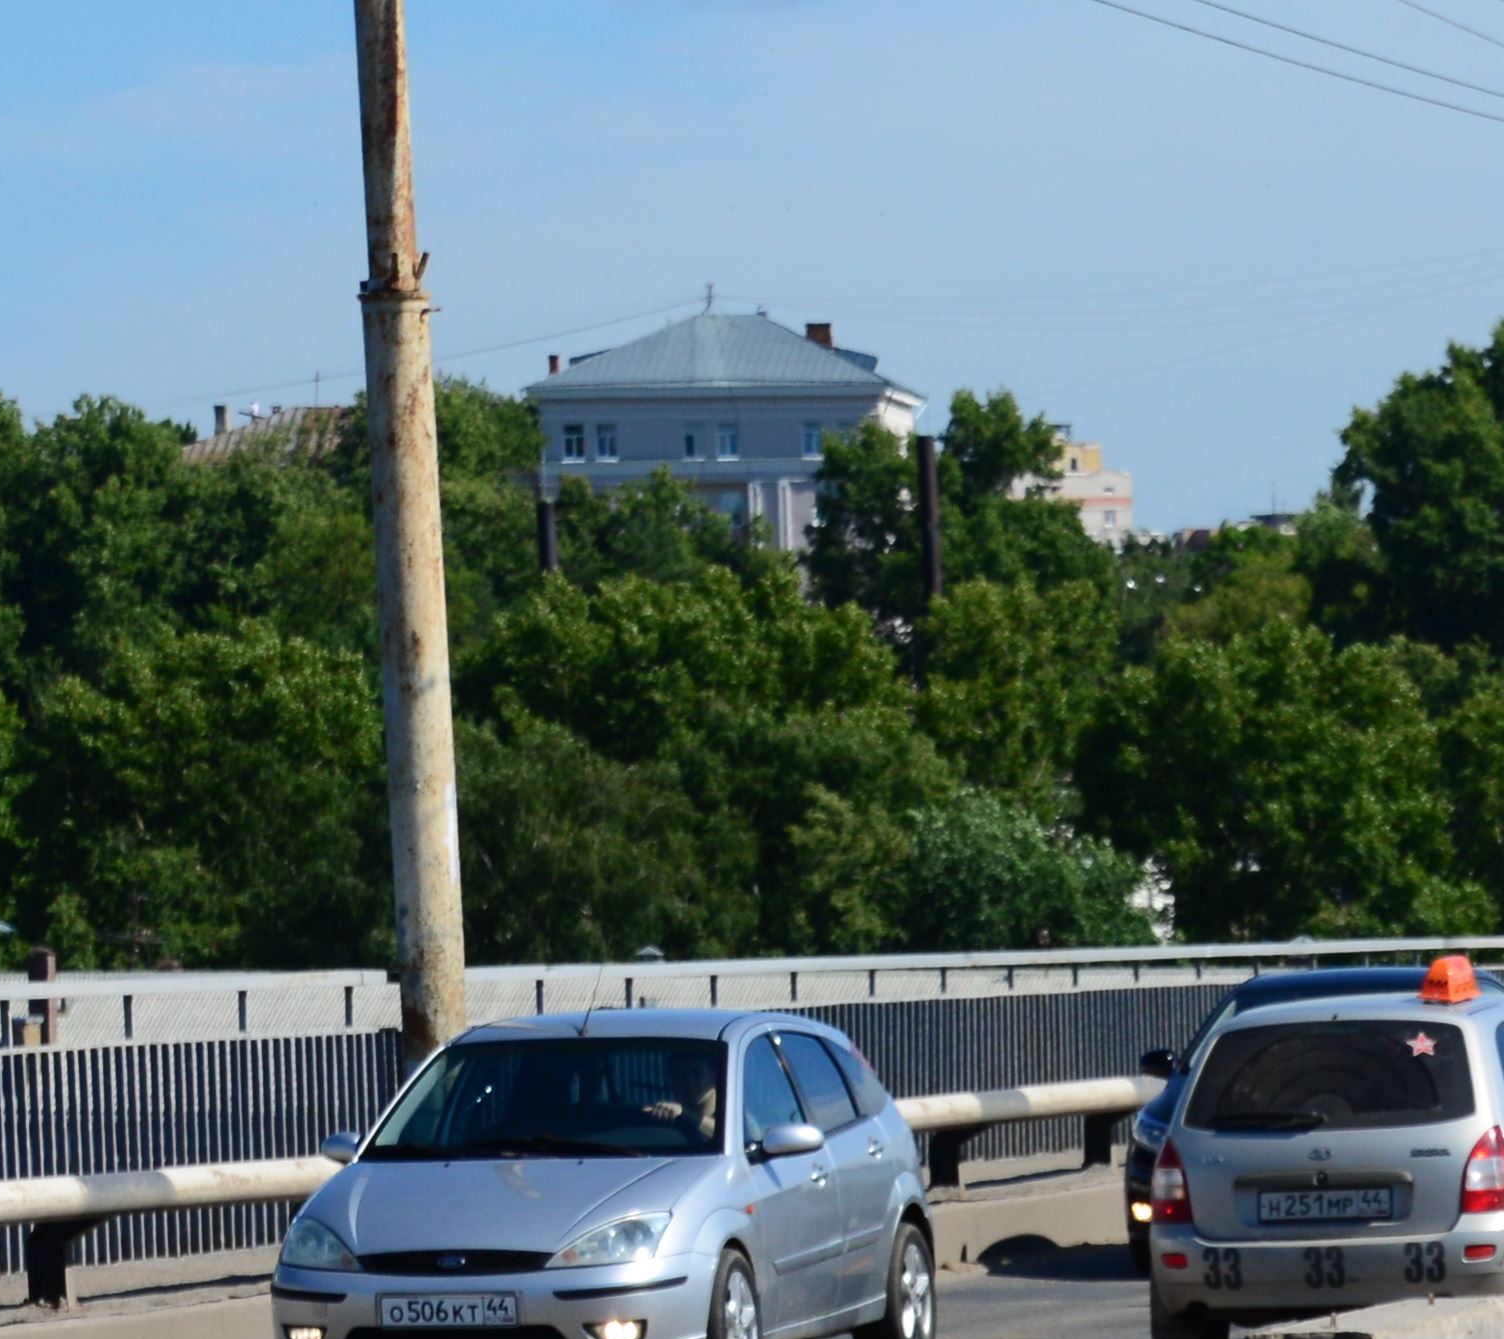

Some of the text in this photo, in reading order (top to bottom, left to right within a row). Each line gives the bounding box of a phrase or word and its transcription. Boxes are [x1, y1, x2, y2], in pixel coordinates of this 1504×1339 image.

[1202, 1248, 1243, 1290] 33
[1302, 1246, 1345, 1289] 33
[1403, 1241, 1446, 1284] 33
[486, 1298, 509, 1316] 44
